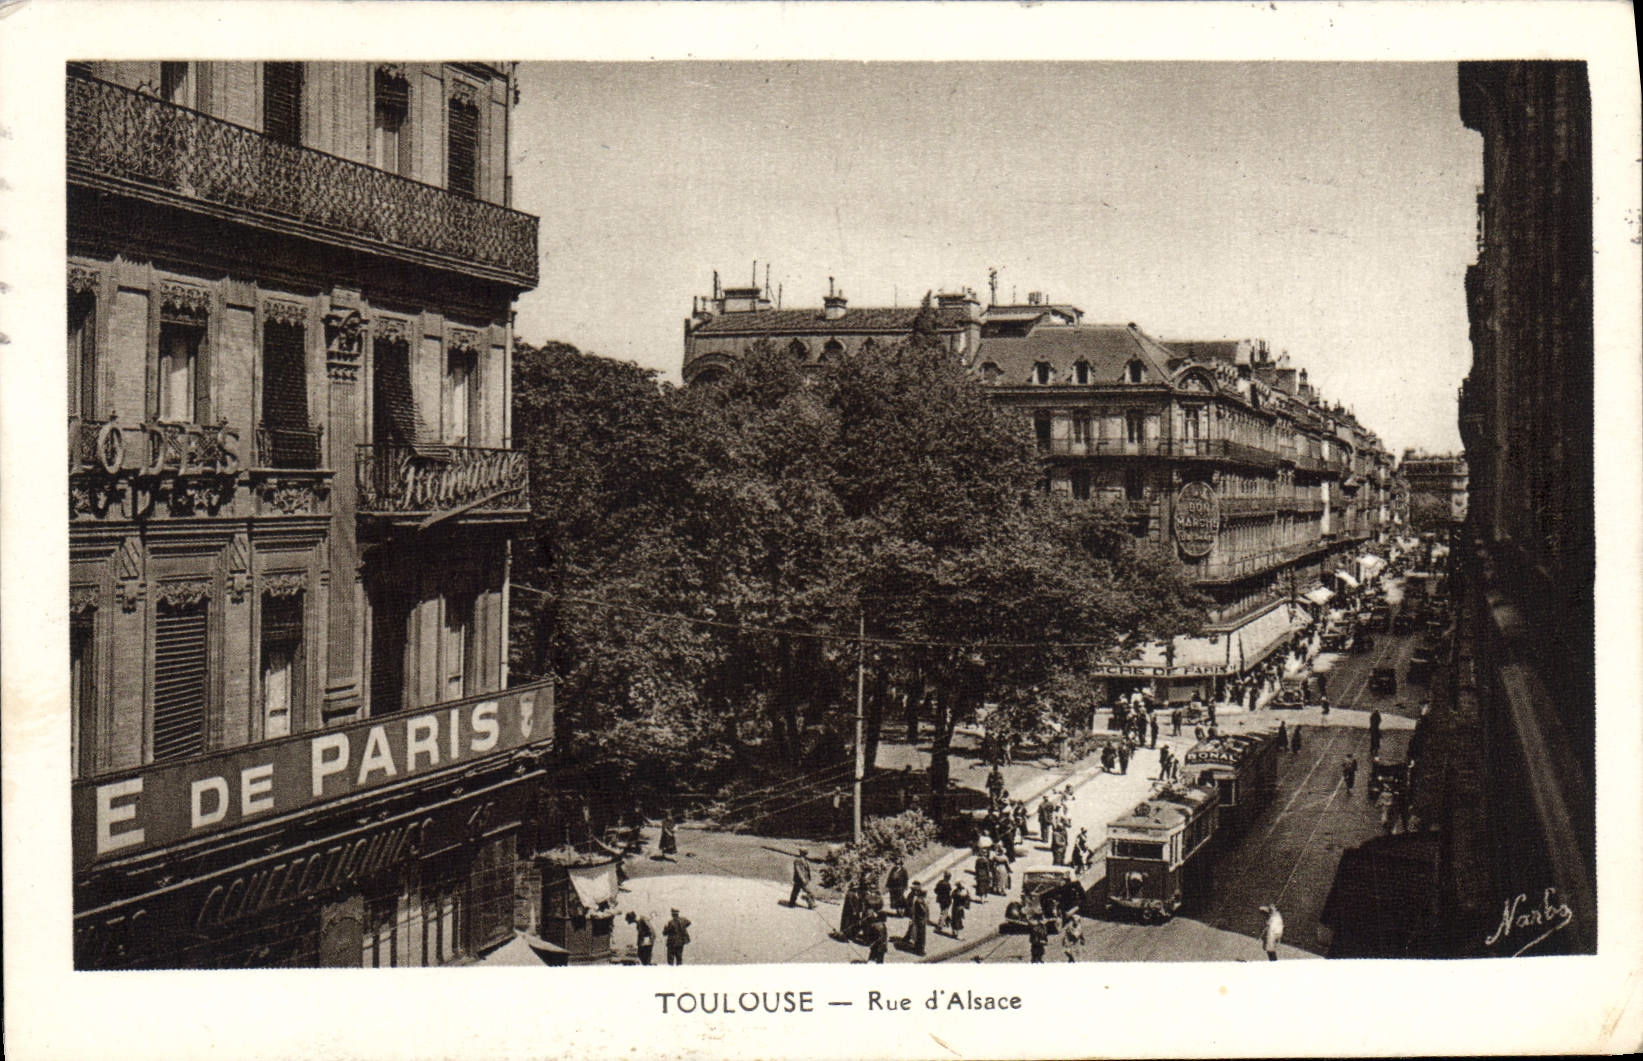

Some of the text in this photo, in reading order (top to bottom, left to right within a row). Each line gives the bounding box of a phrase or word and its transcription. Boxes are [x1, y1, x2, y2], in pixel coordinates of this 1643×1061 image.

[1153, 666, 1178, 677] DE
[96, 700, 500, 856] E DE PARIS
